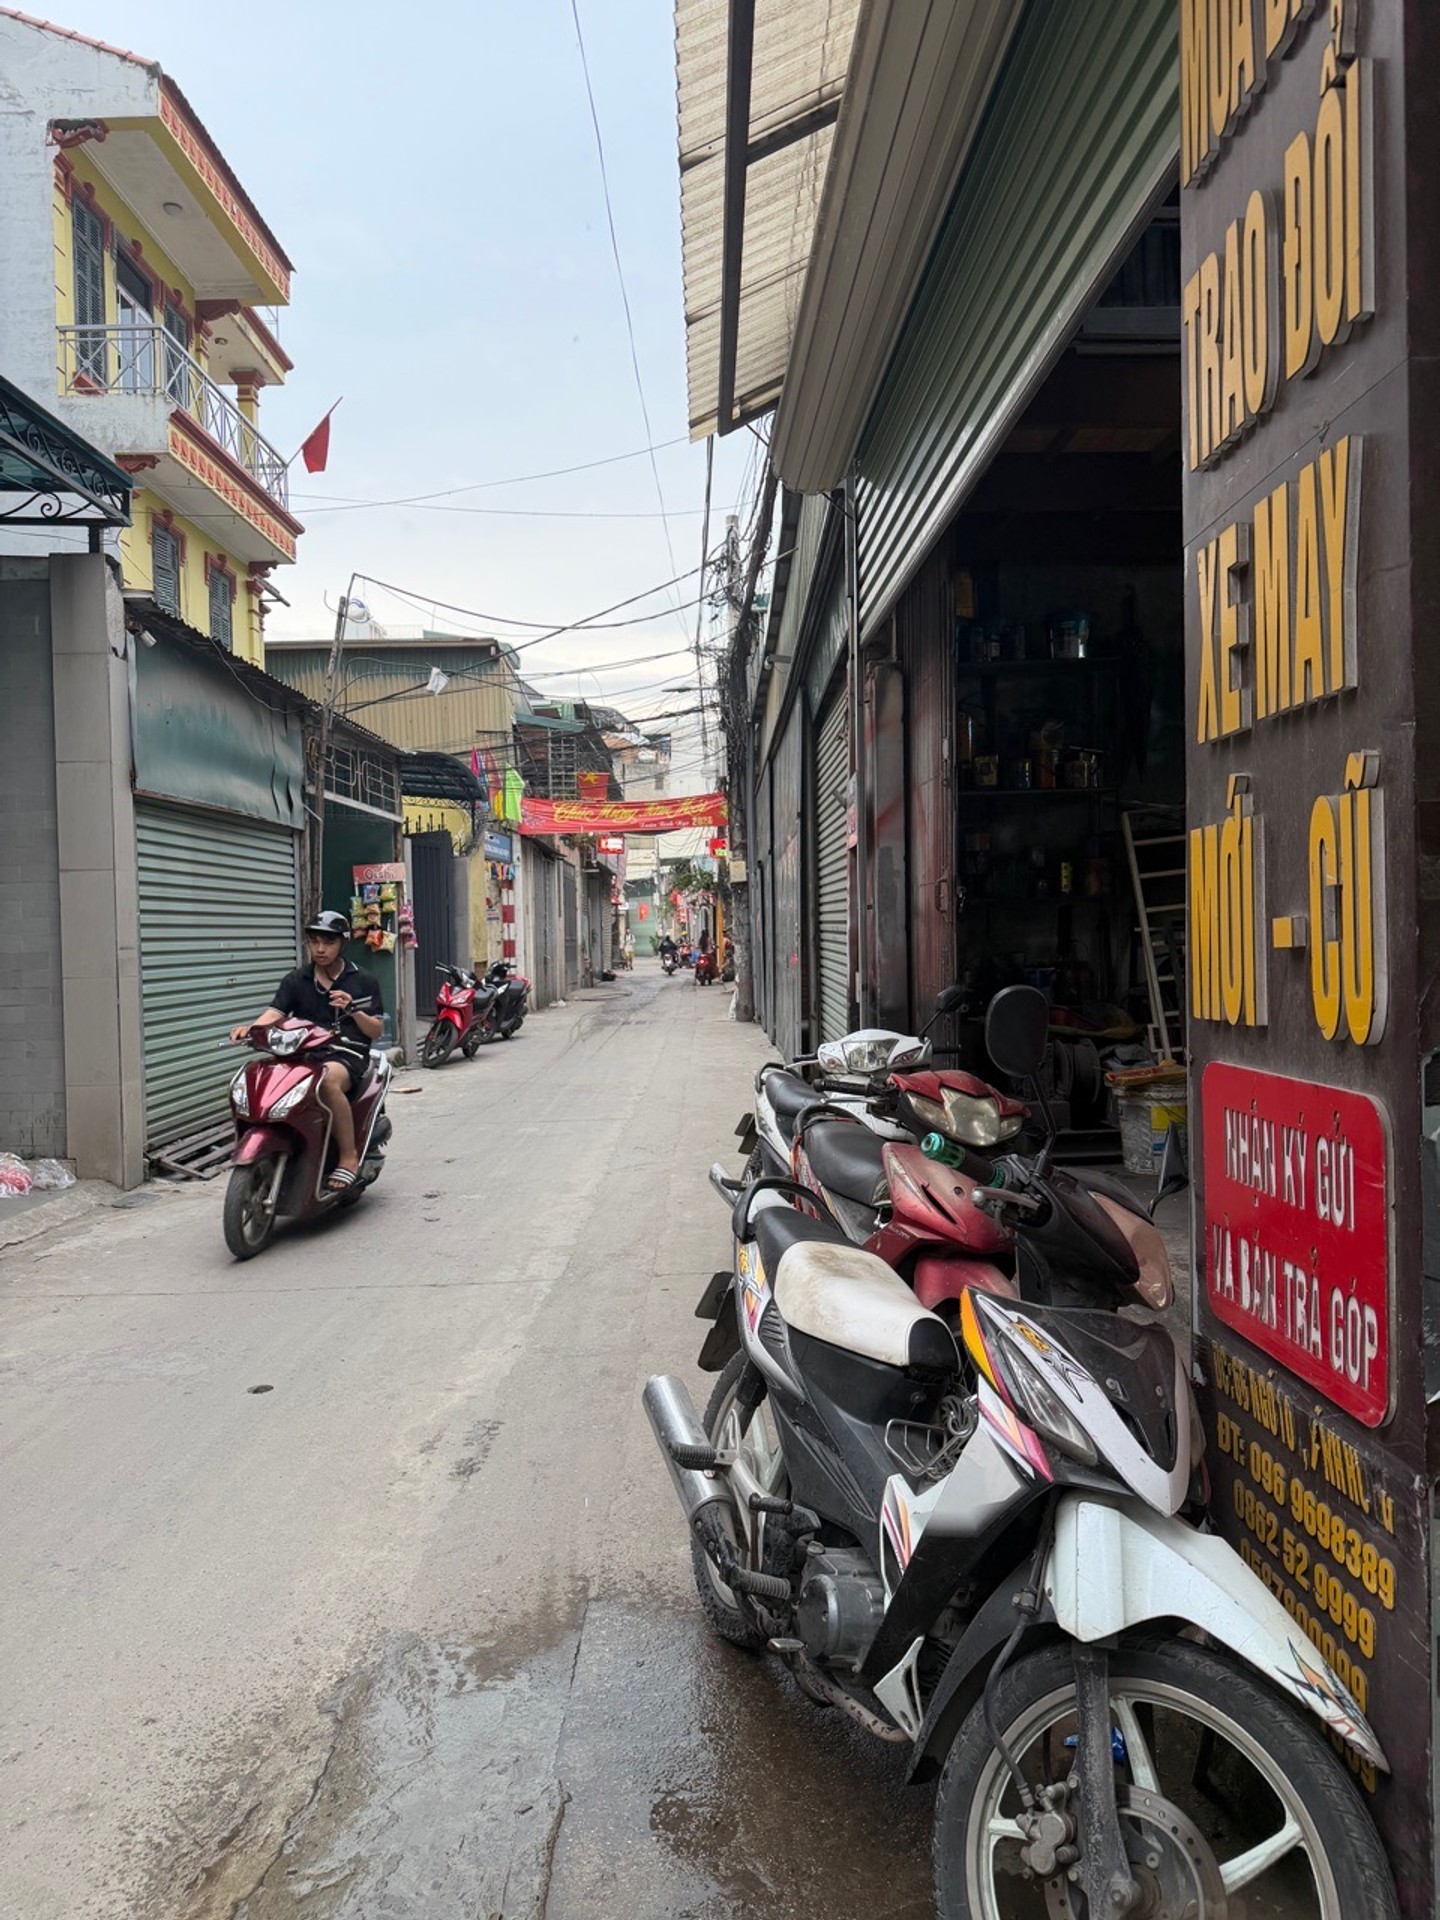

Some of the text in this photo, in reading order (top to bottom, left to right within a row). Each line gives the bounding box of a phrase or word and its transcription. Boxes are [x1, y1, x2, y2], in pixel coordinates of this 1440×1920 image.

[1185, 189, 1268, 473] TRAO
[1284, 0, 1361, 381] ĐỔI
[1197, 521, 1242, 745] XE
[1190, 772, 1256, 1027] MỚI
[1309, 751, 1373, 1046] CŨ
[1224, 1098, 1356, 1233] NHẬN KÝ GỬI
[1212, 1212, 1379, 1392] VÀ BÁN TRẢ GÓP
[1232, 1478, 1375, 1660] 0862 52 9999
[1249, 1441, 1286, 1507] 096
[1289, 1477, 1397, 1611] 9698389
